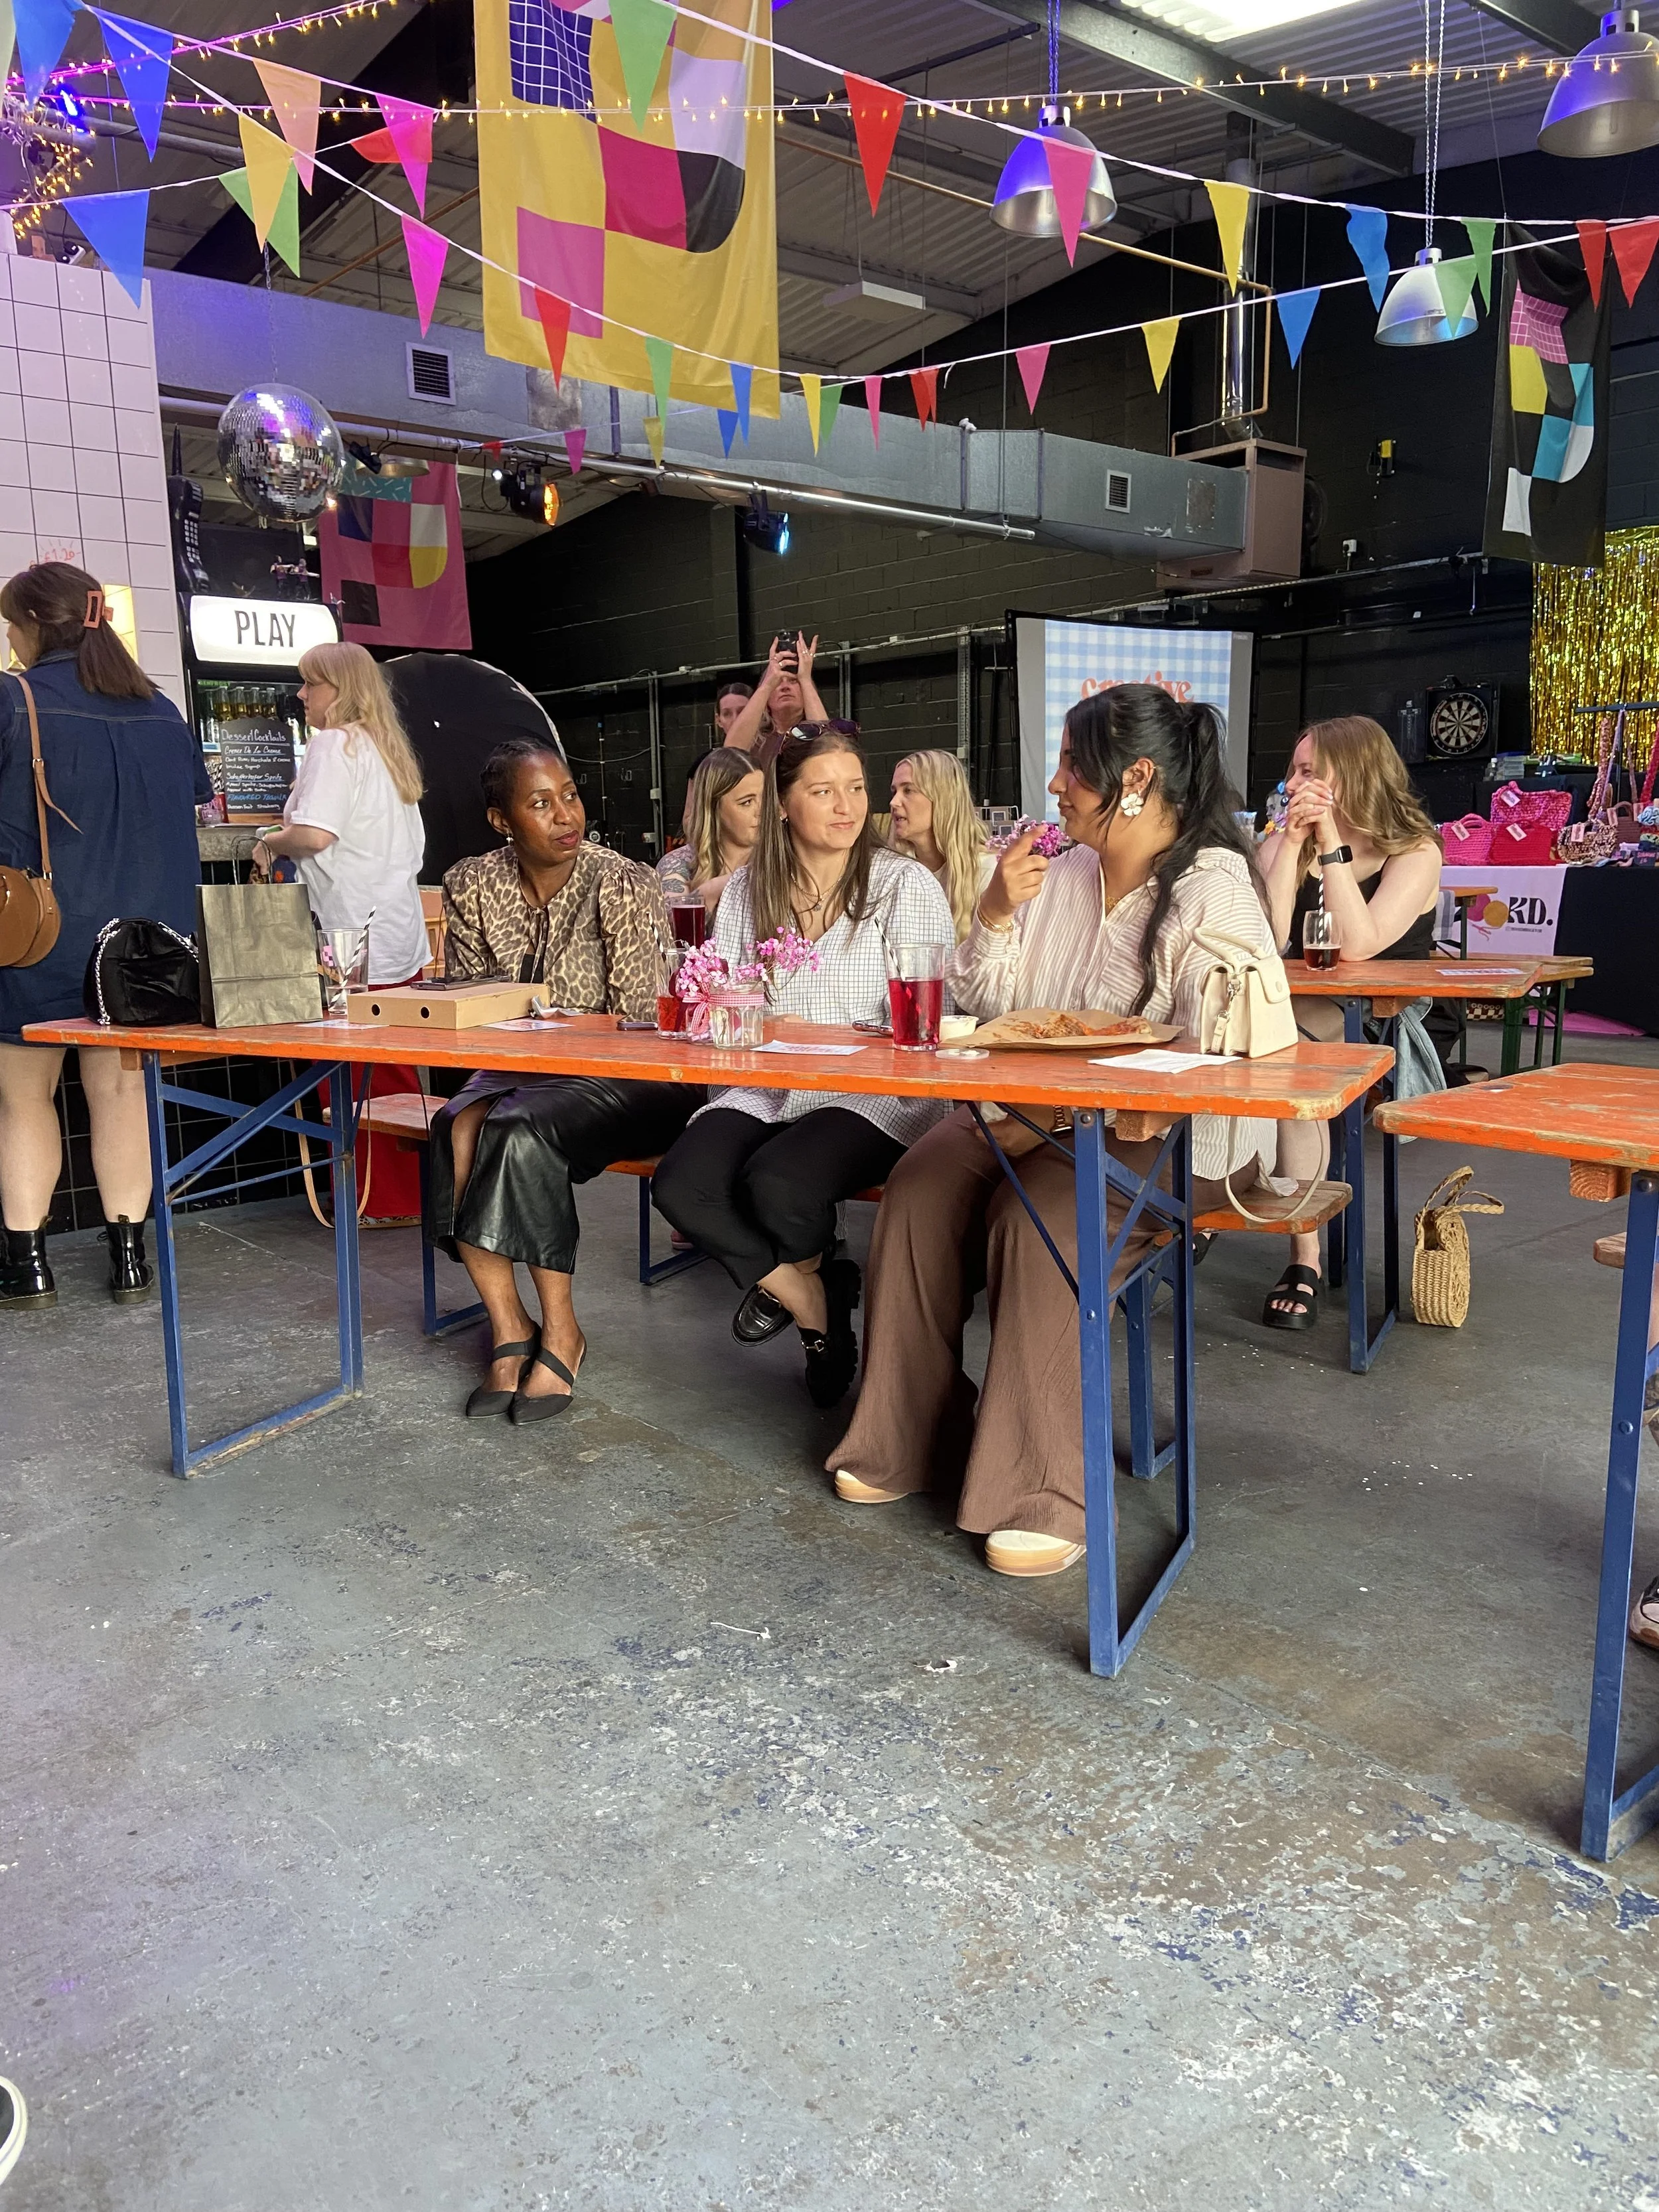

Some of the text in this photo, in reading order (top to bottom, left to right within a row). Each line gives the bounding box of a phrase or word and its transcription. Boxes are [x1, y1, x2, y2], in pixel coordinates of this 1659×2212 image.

[234, 610, 295, 648] PLAY
[221, 729, 287, 741] Dessert Cocktails
